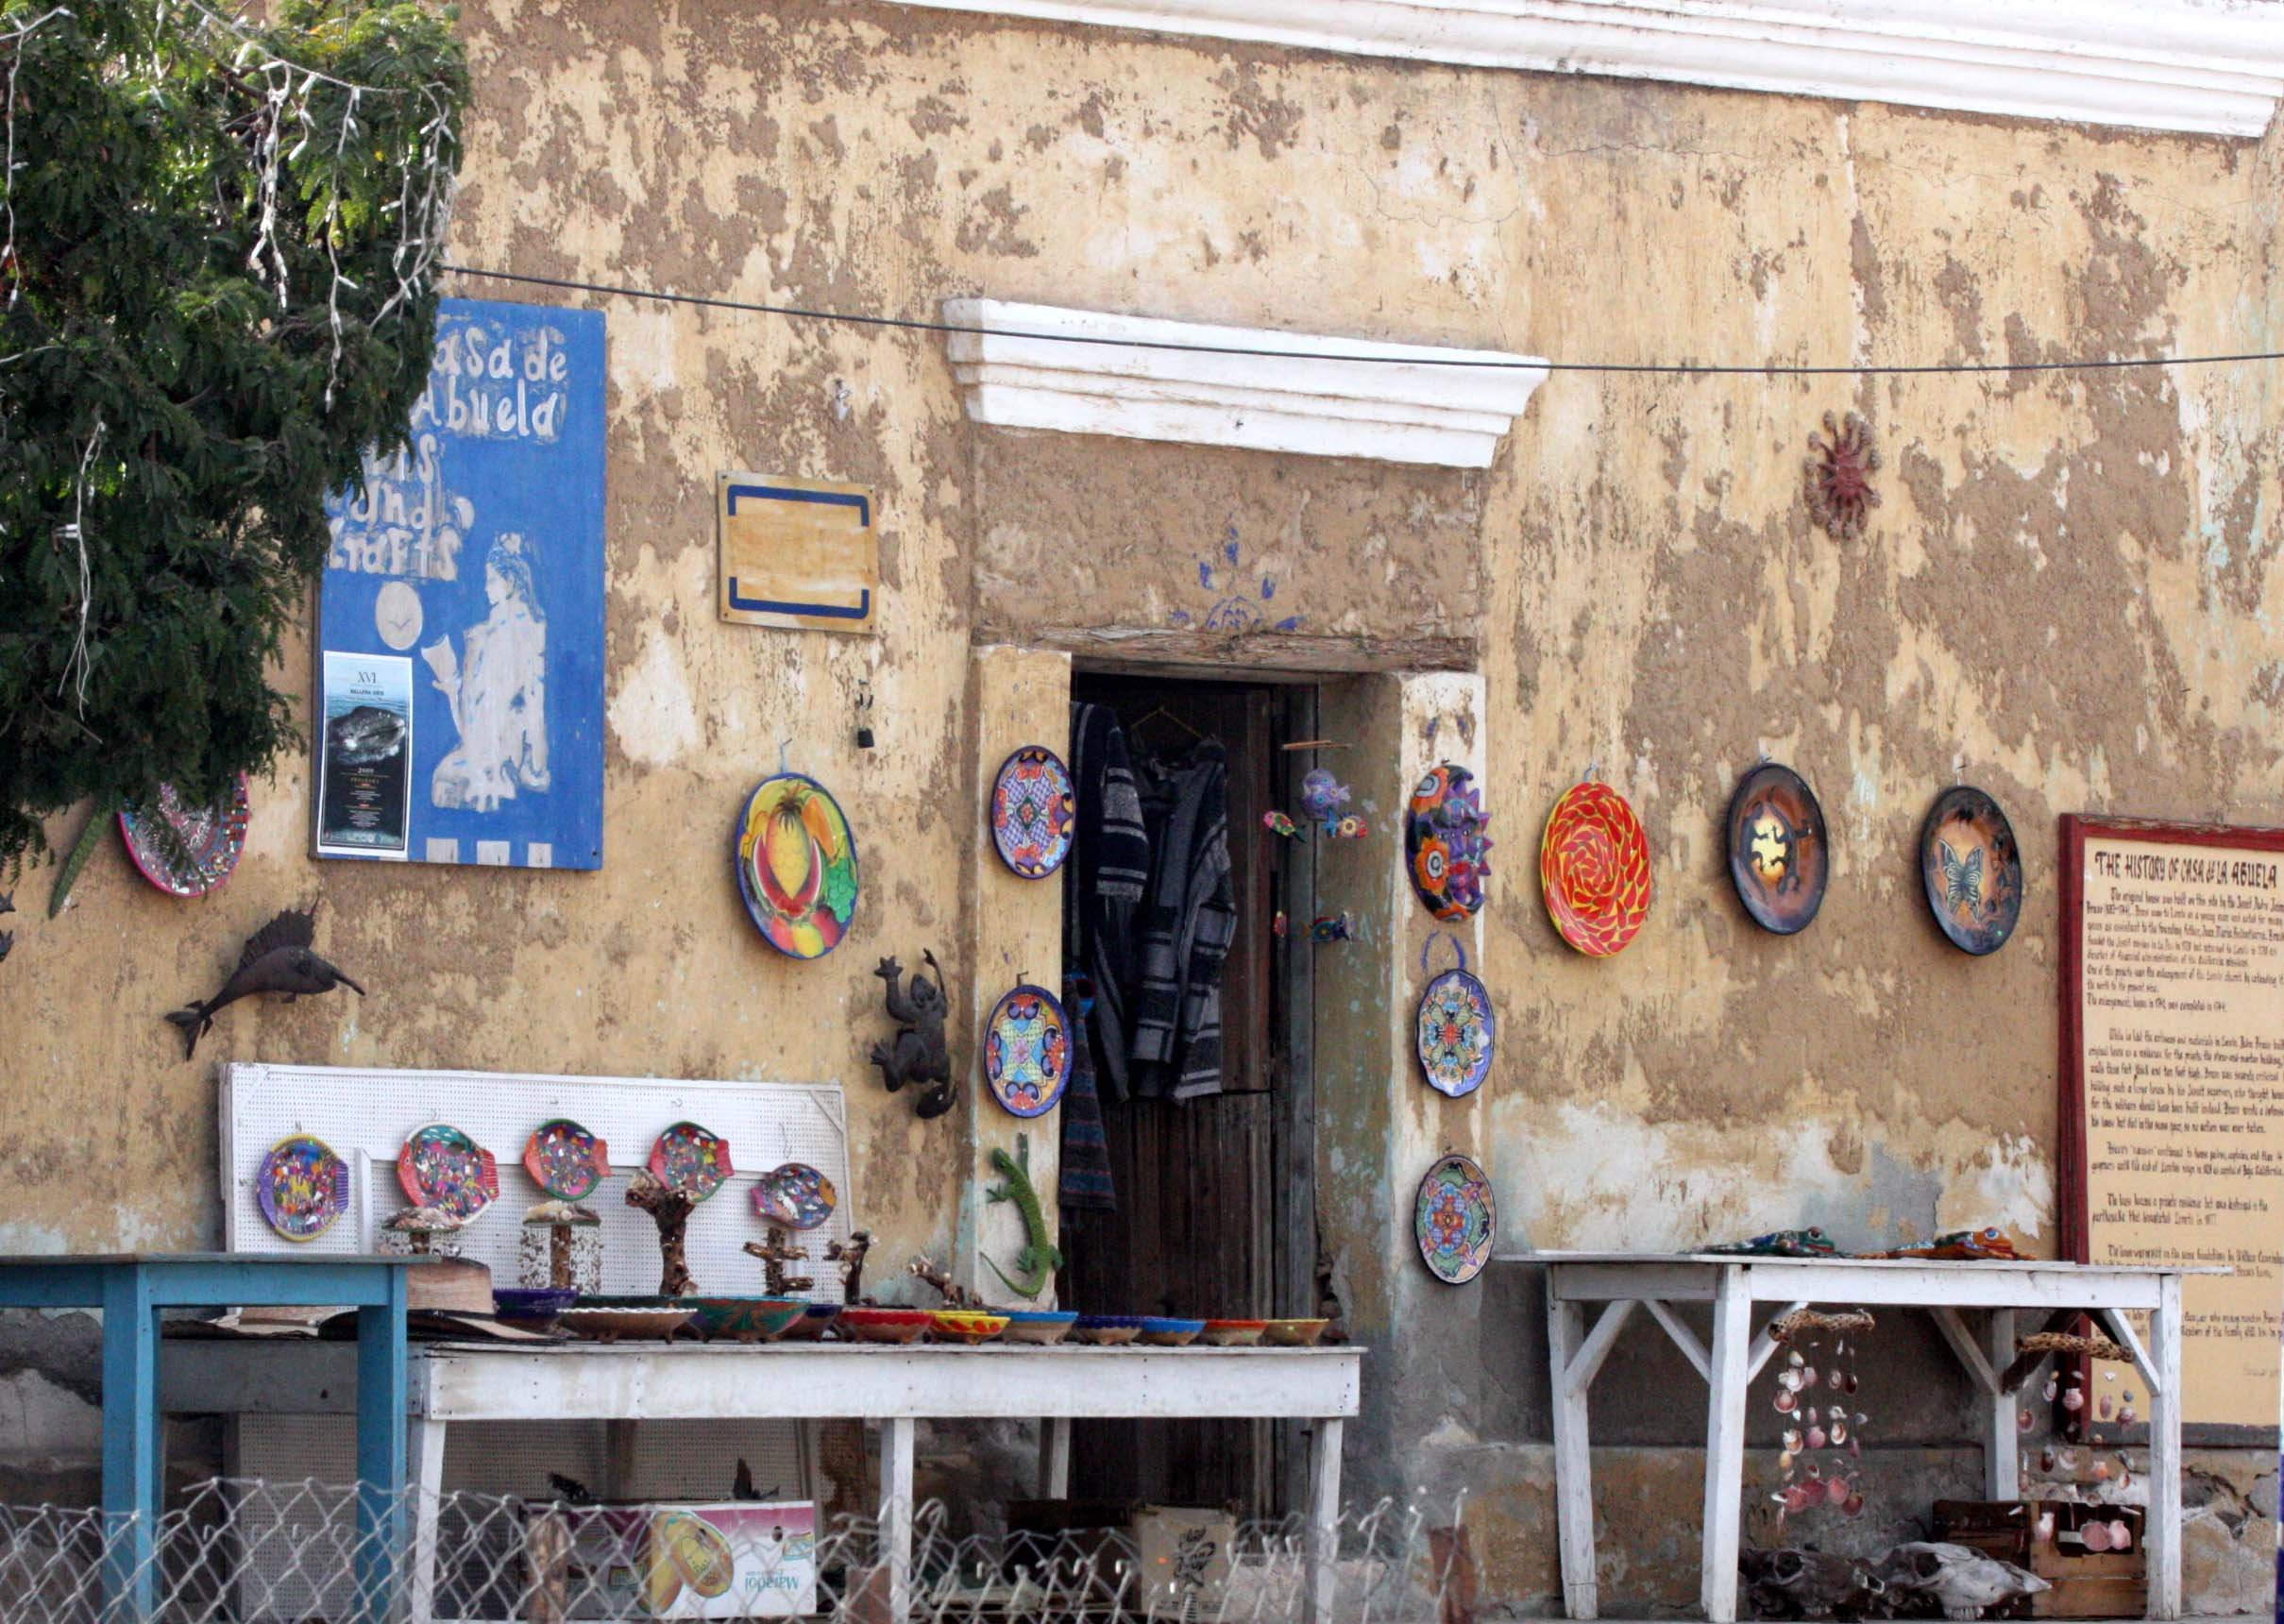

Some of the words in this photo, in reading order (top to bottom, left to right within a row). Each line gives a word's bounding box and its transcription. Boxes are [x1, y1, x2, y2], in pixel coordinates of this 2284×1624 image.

[523, 328, 567, 382] de
[410, 373, 561, 437] Abuela
[2095, 851, 2121, 878] THE
[2124, 854, 2166, 882] HISTORY
[2168, 856, 2178, 881] OF
[2181, 858, 2205, 883] CASA
[2217, 861, 2227, 885] LA
[2231, 862, 2277, 889] ABUELA
